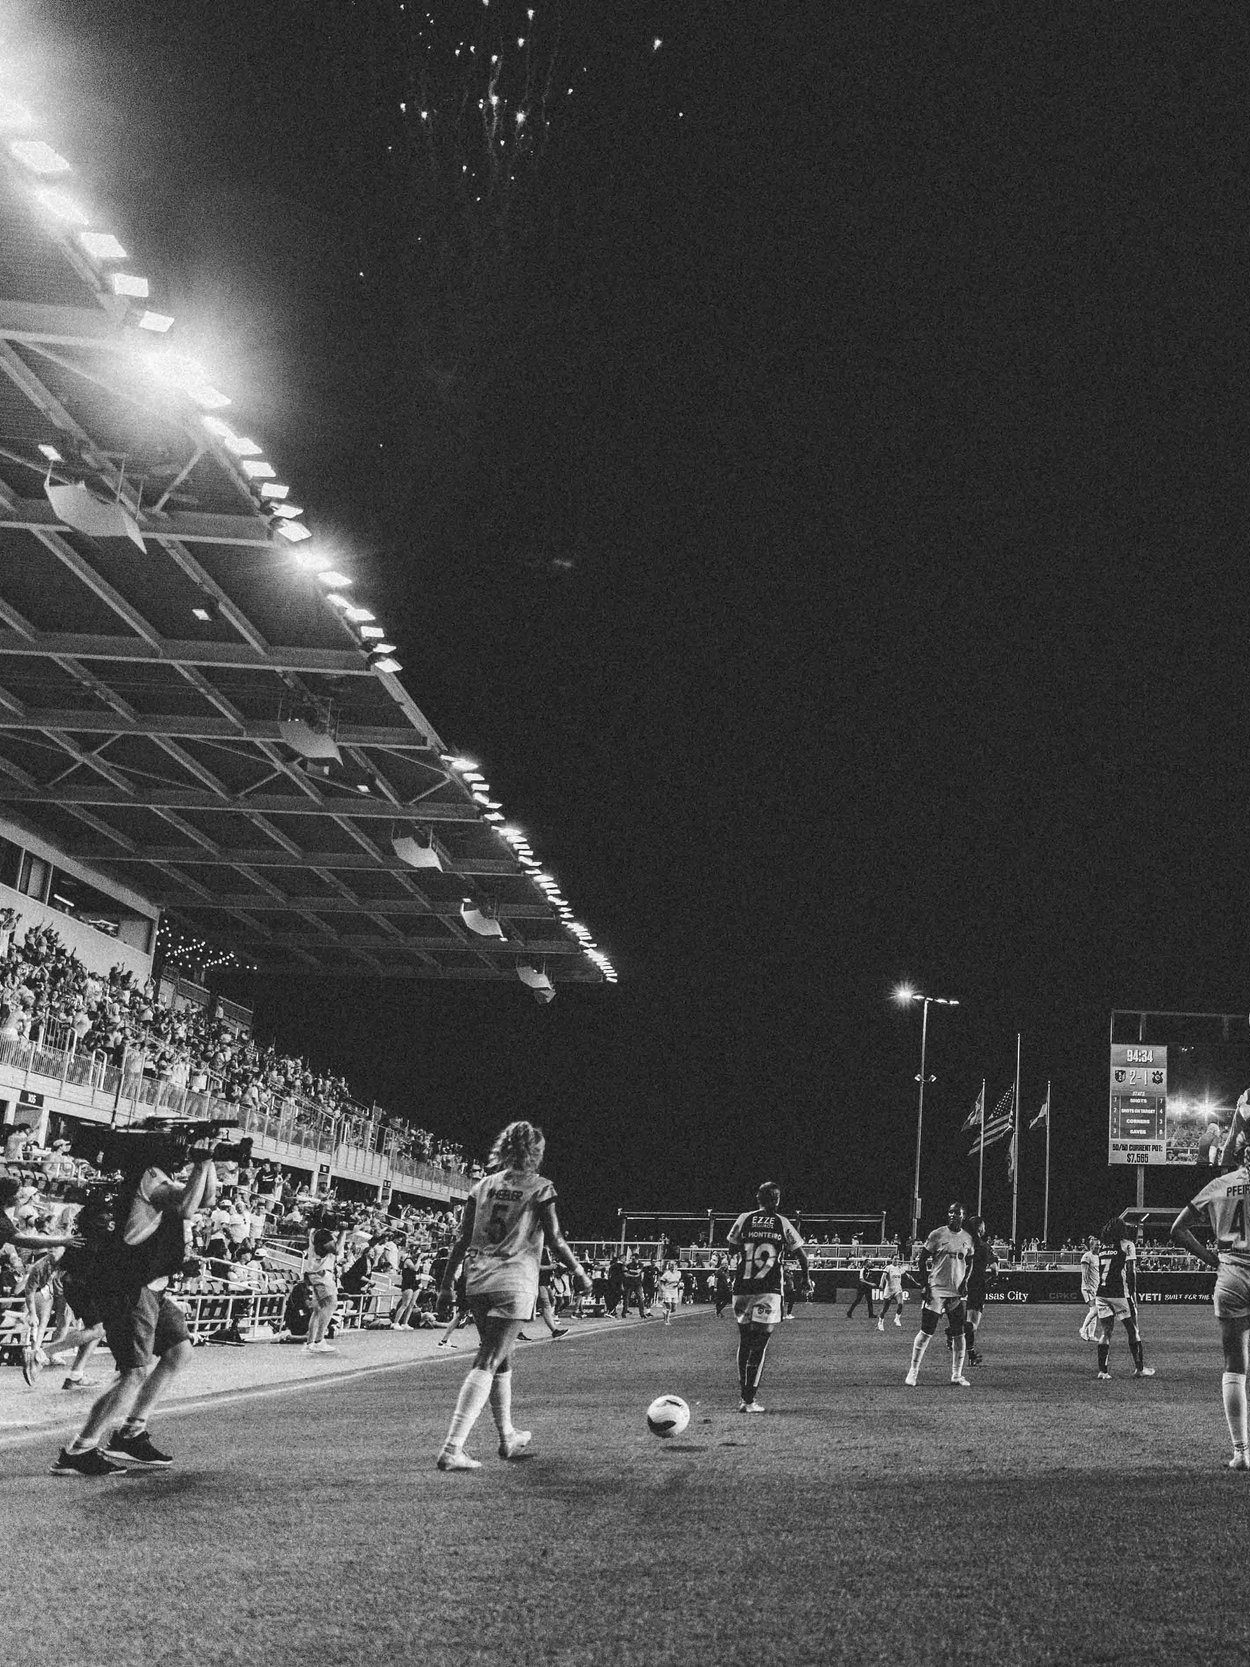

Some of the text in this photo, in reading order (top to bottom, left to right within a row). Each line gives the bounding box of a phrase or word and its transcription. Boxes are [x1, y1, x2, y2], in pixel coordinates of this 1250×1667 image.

[1127, 1050, 1153, 1062] 94:34
[752, 1216, 775, 1225] EZZE
[743, 1243, 776, 1280] 19
[1100, 1259, 1112, 1287] 7
[1007, 1291, 1029, 1302] City
[1138, 1293, 1162, 1301] YETI
